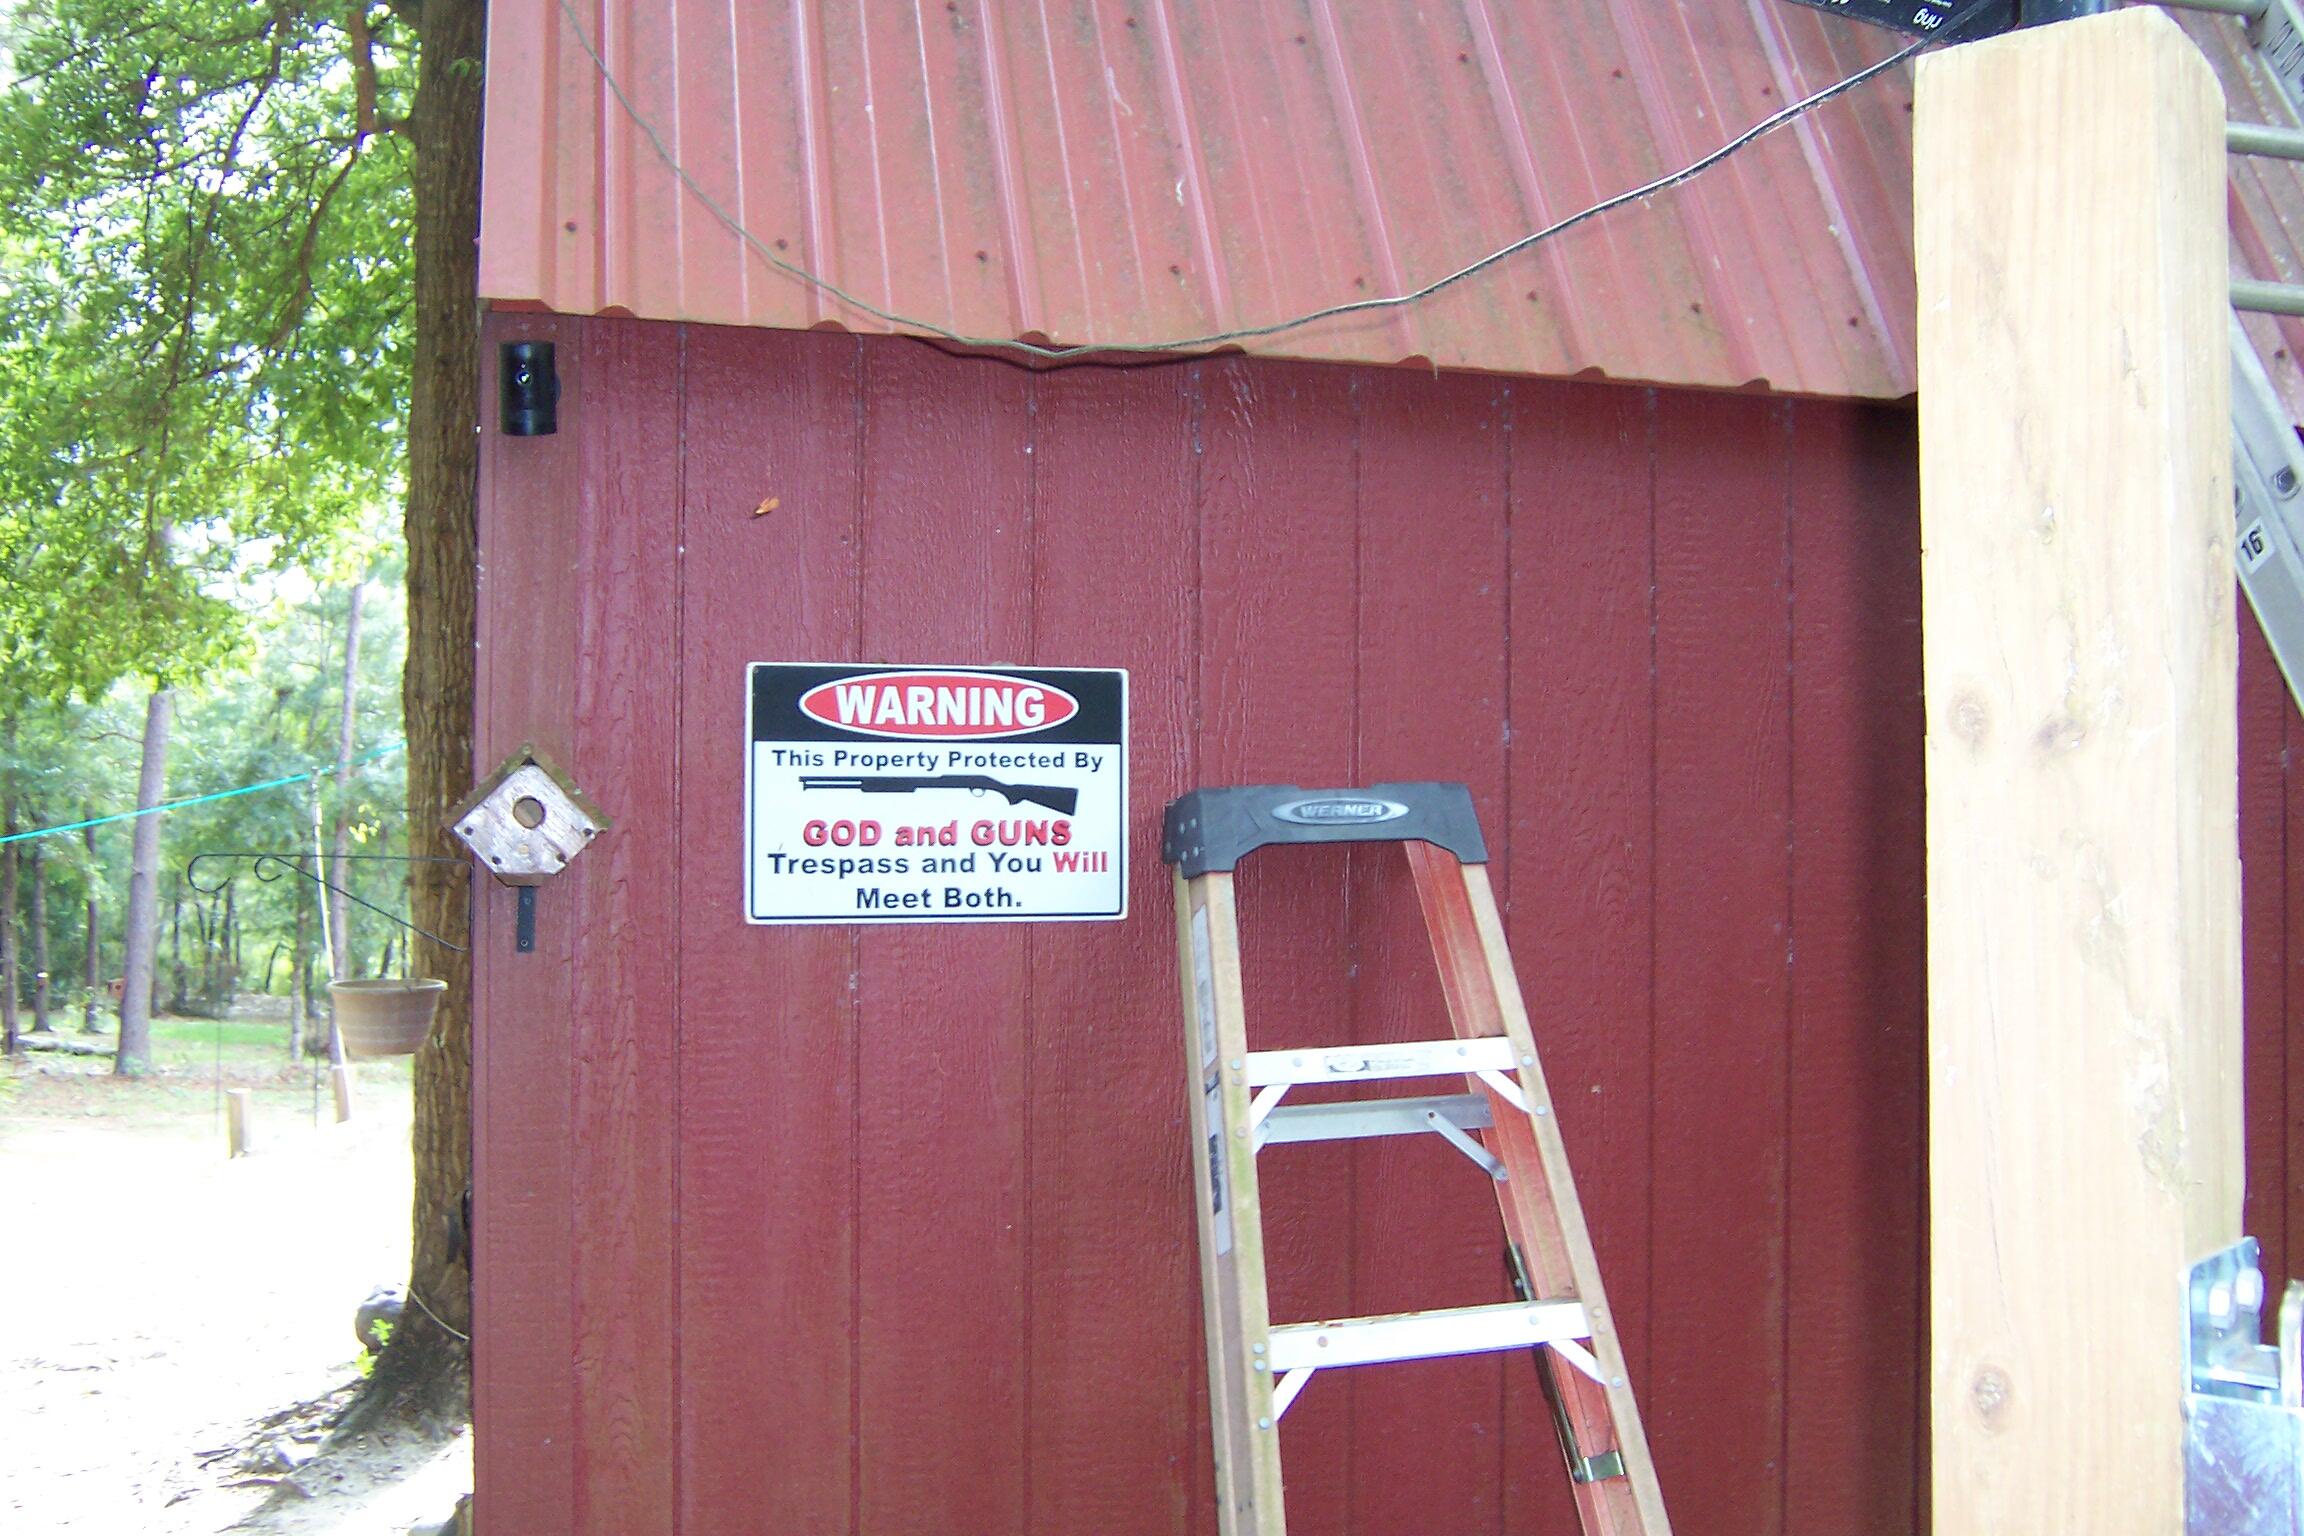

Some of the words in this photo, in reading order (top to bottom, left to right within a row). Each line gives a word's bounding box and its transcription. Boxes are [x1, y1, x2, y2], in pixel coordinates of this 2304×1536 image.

[1913, 8, 1943, 30] ring
[835, 685, 1046, 726] WARNING
[772, 750, 824, 767] This
[834, 750, 939, 772] Property
[949, 751, 1065, 768] Protected
[1075, 752, 1103, 772] By
[1300, 804, 1383, 817] WERNER
[803, 819, 882, 847] GOD
[895, 820, 958, 846] and
[971, 819, 1073, 847] GUNS
[768, 853, 909, 879] Trespass
[921, 852, 976, 874] and
[988, 852, 1042, 873] You
[1053, 851, 1108, 873] Will
[856, 888, 932, 909] Meet
[944, 887, 1022, 908] Both.
